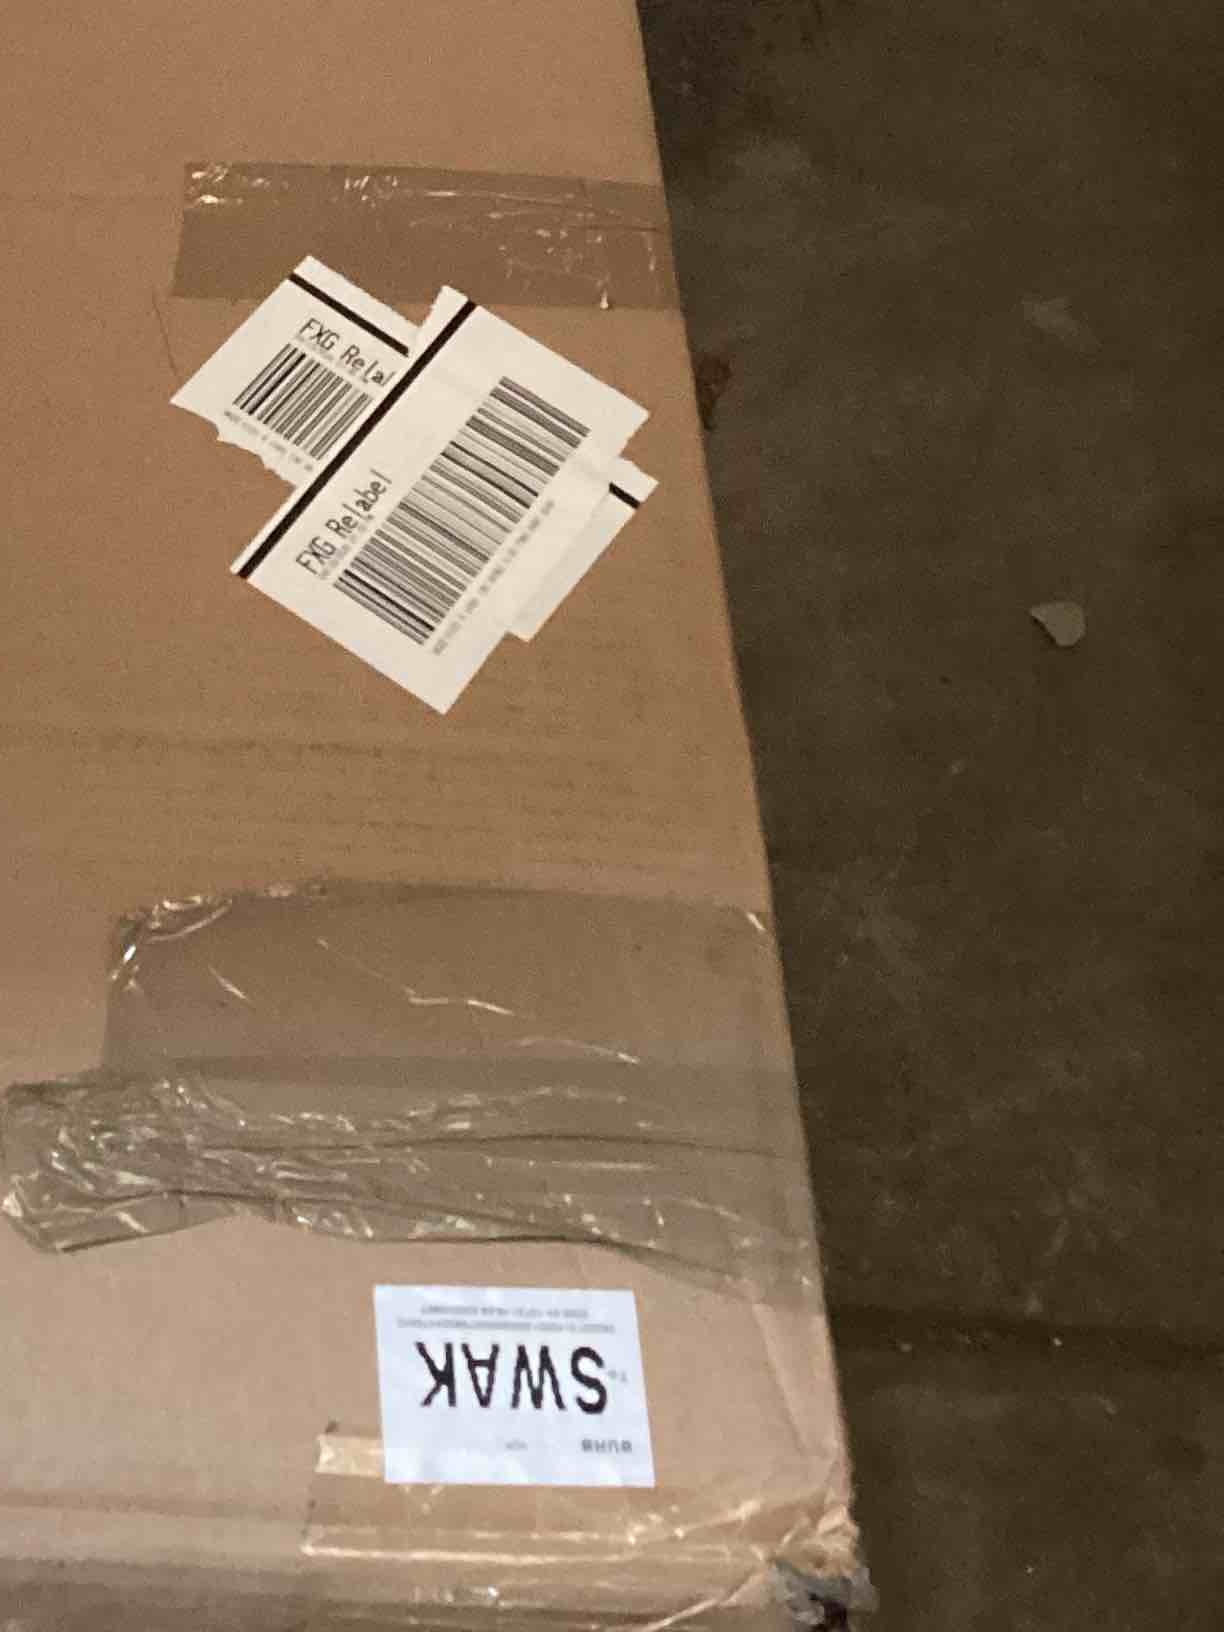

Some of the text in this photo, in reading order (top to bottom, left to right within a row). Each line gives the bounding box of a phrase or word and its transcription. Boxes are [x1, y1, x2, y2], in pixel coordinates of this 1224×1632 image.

[299, 317, 340, 351] FXG
[296, 468, 392, 574] FXG Relabel
[414, 1340, 609, 1415] SWAK
